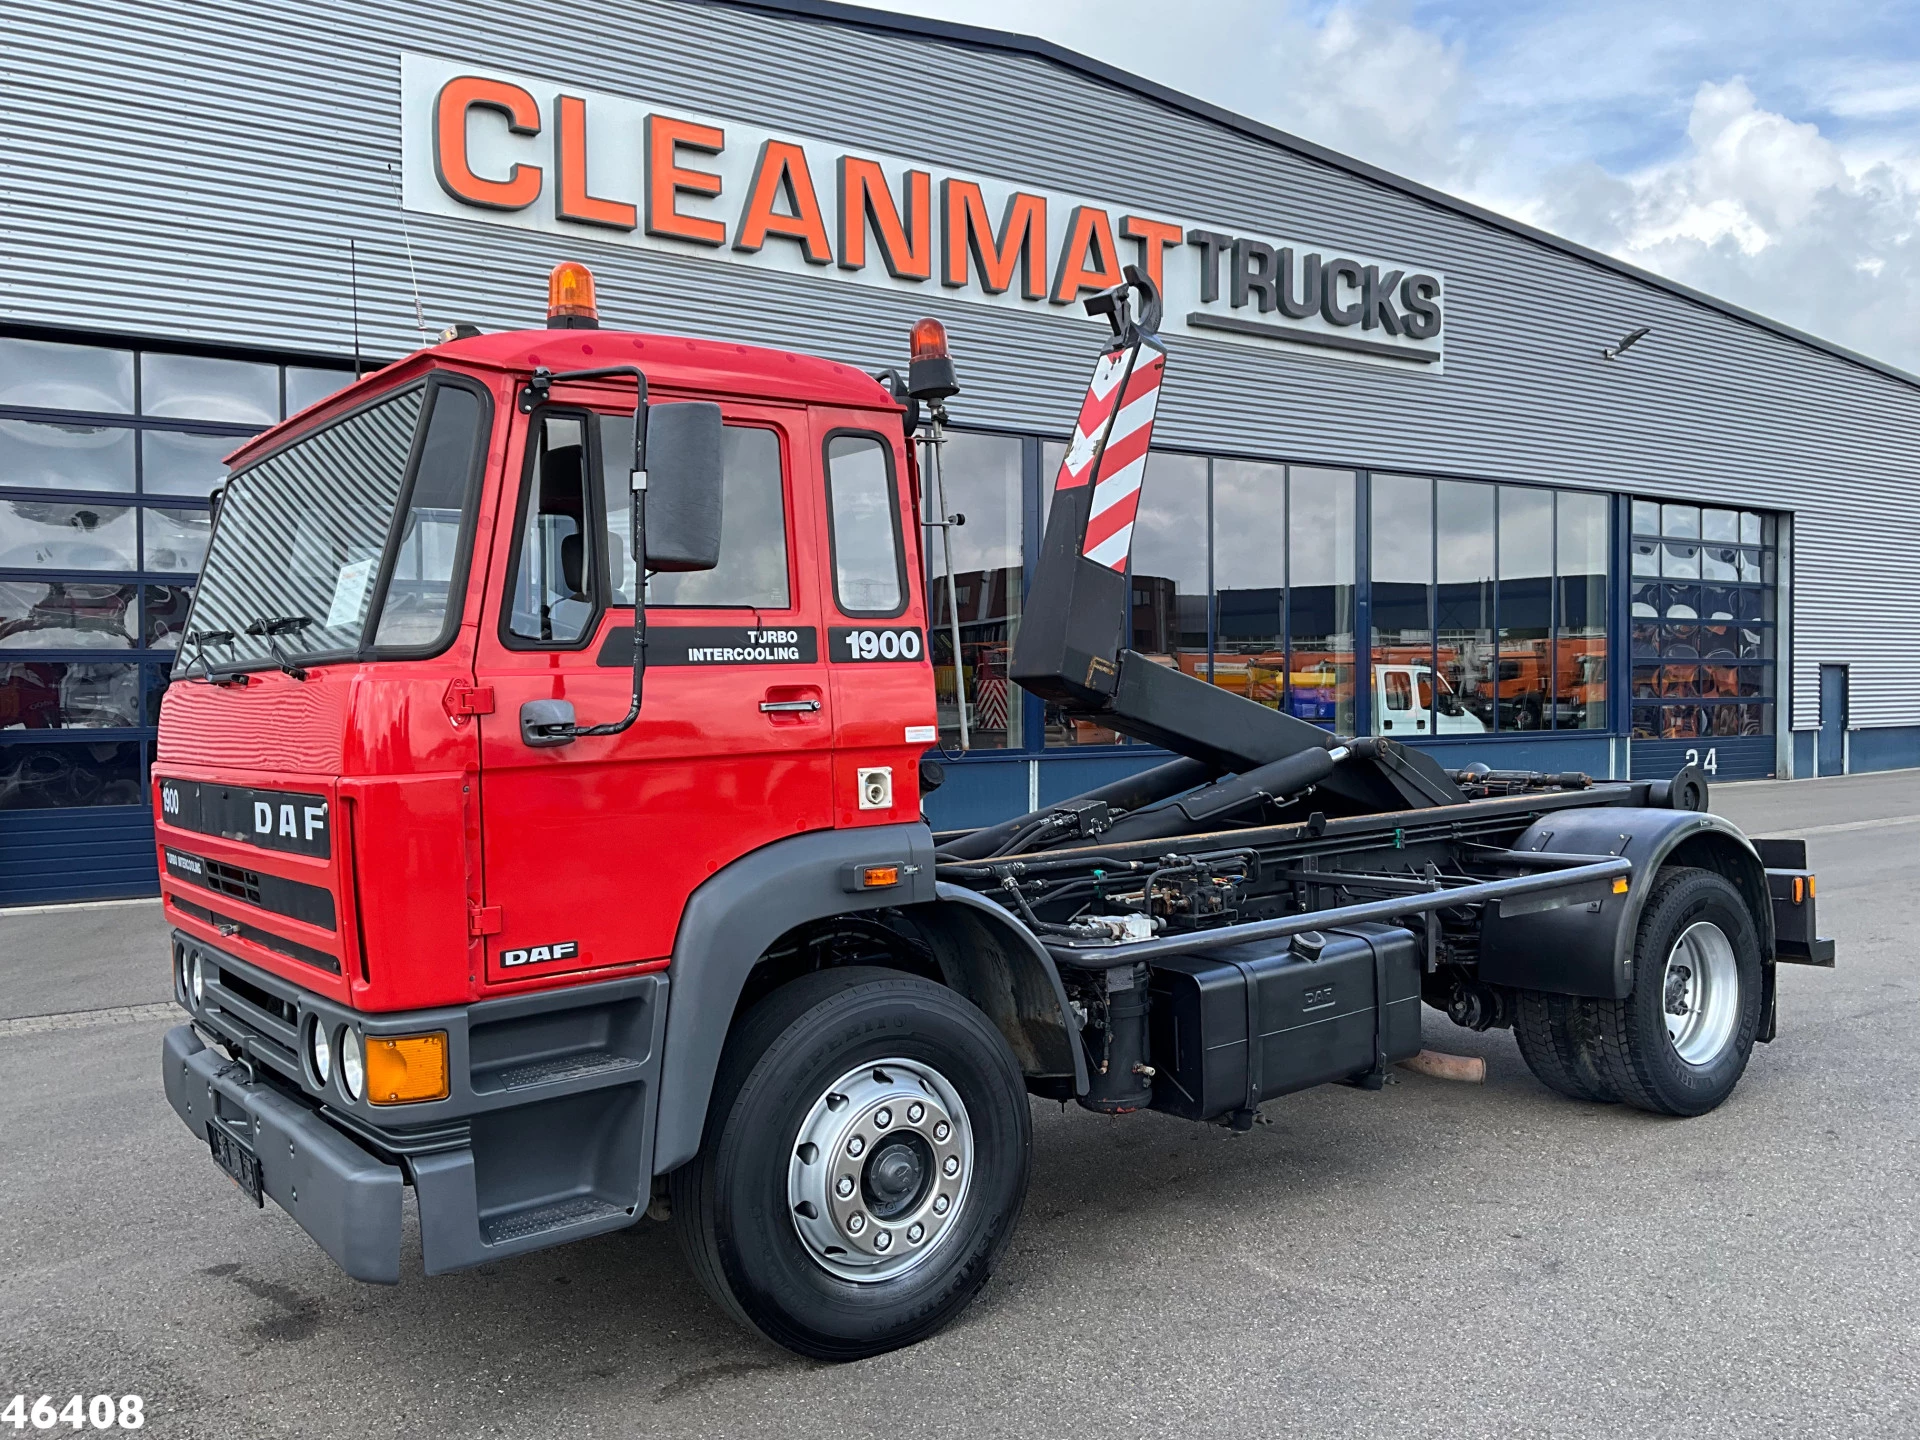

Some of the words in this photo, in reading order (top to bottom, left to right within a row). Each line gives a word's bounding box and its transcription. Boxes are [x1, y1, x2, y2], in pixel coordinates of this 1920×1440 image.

[432, 75, 1183, 320] CLEANMAT
[1187, 229, 1442, 340] TRUCKS
[747, 630, 798, 644] TURBO
[845, 630, 920, 660] 1900
[688, 647, 799, 661] INTERCOOLING
[162, 786, 179, 815] 1900
[254, 801, 325, 841] DAF
[505, 942, 576, 966] DAF
[1304, 987, 1333, 1004] DAF
